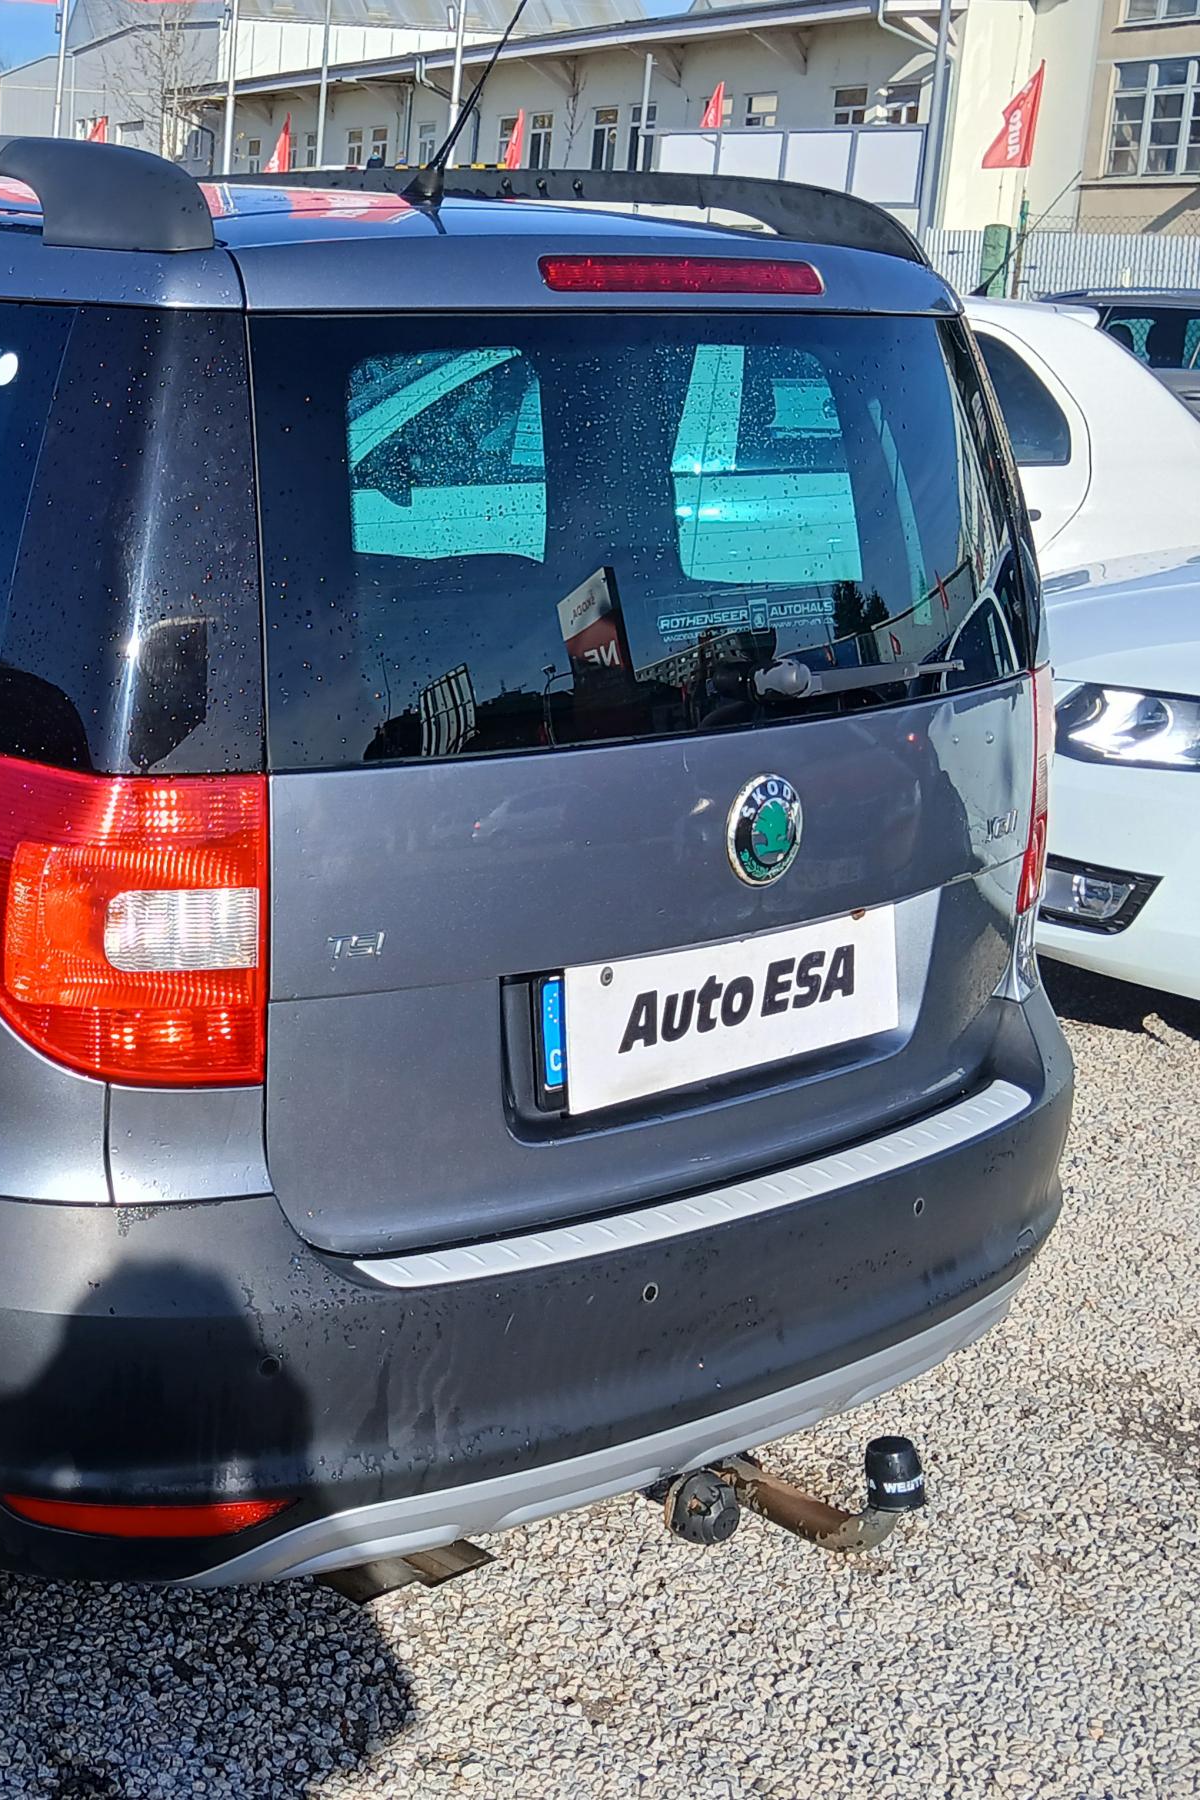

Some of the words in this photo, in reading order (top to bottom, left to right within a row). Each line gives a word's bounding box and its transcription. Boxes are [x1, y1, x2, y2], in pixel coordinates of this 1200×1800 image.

[660, 610, 749, 630] ROTHENSEER
[770, 600, 833, 617] AUTOHAUS
[617, 973, 754, 1055] Auto
[760, 944, 855, 1017] ESA
[549, 1048, 562, 1072] C
